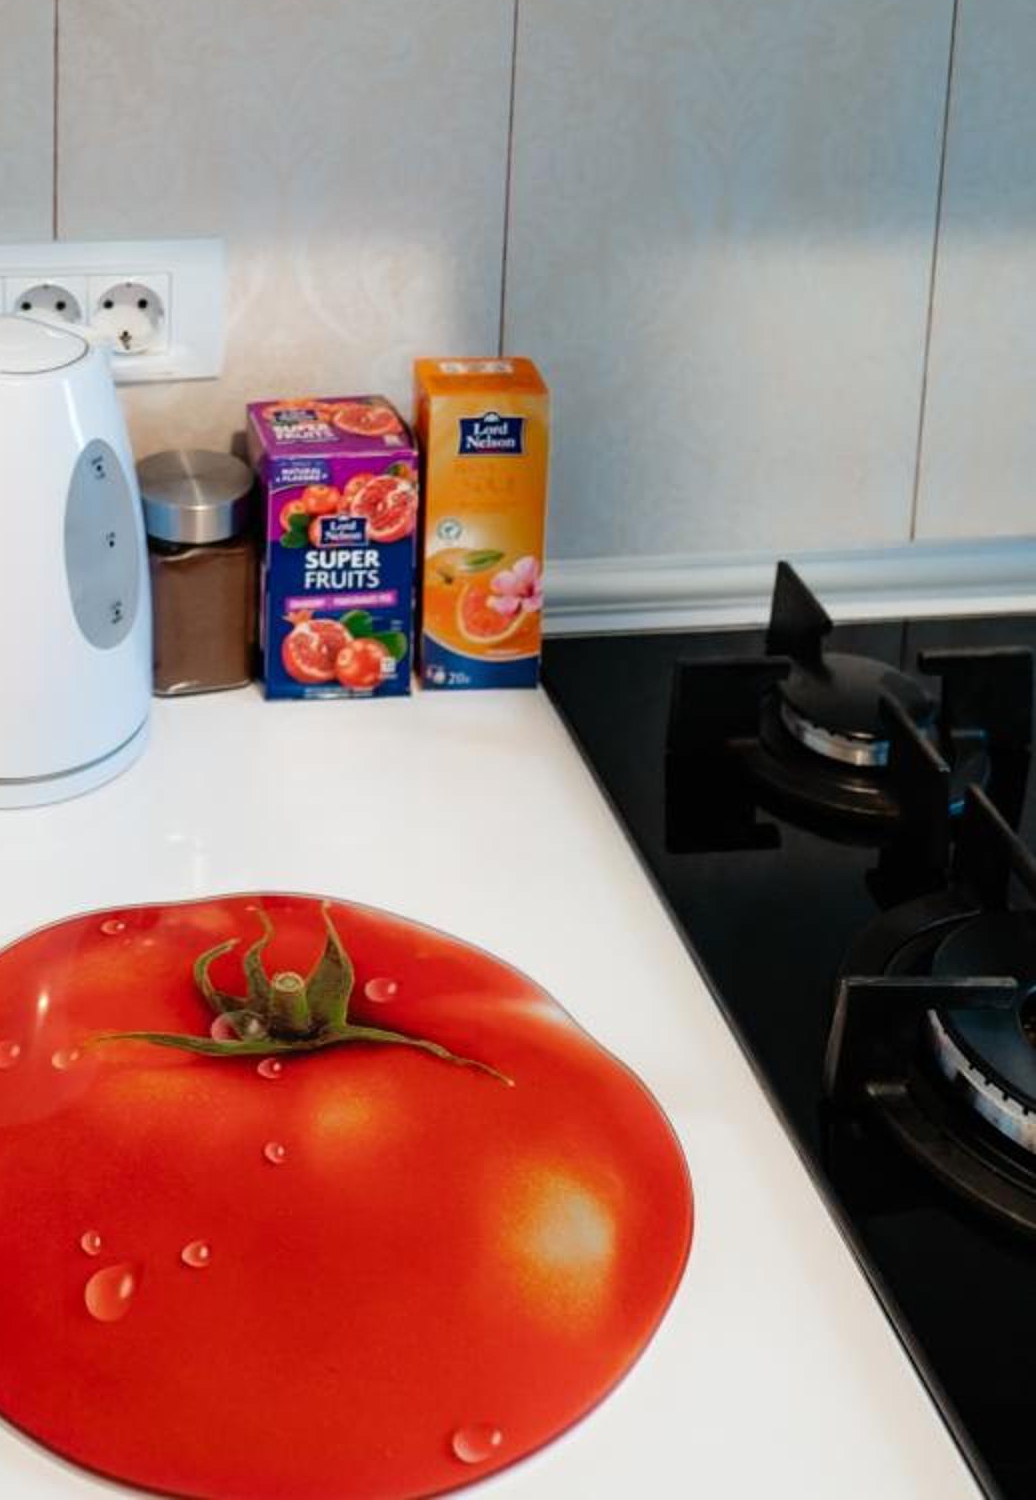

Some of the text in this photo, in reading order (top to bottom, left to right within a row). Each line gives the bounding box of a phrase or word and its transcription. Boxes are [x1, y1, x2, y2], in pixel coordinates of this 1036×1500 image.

[474, 422, 509, 436] Lord
[466, 435, 517, 449] Nelson
[330, 520, 357, 531] Lord
[304, 550, 381, 569] SUPER
[304, 569, 381, 590] FRUITS
